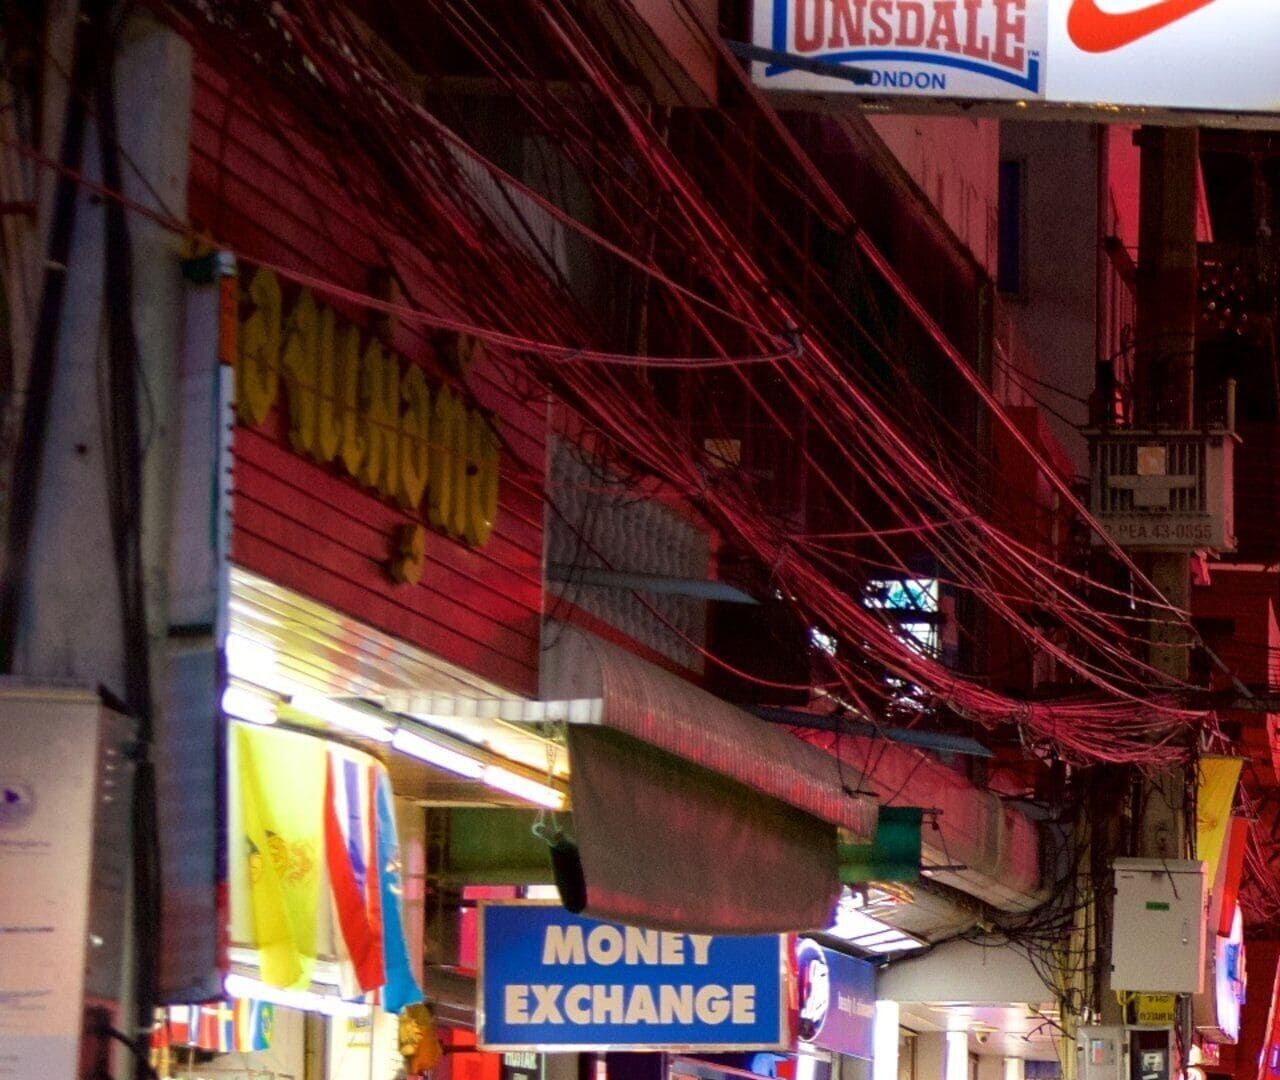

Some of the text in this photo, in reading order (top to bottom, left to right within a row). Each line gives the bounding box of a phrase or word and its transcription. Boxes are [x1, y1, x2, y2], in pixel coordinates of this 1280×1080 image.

[854, 68, 946, 90] ONDON
[541, 924, 715, 966] MONEY
[504, 984, 757, 1025] EXCHANGE
